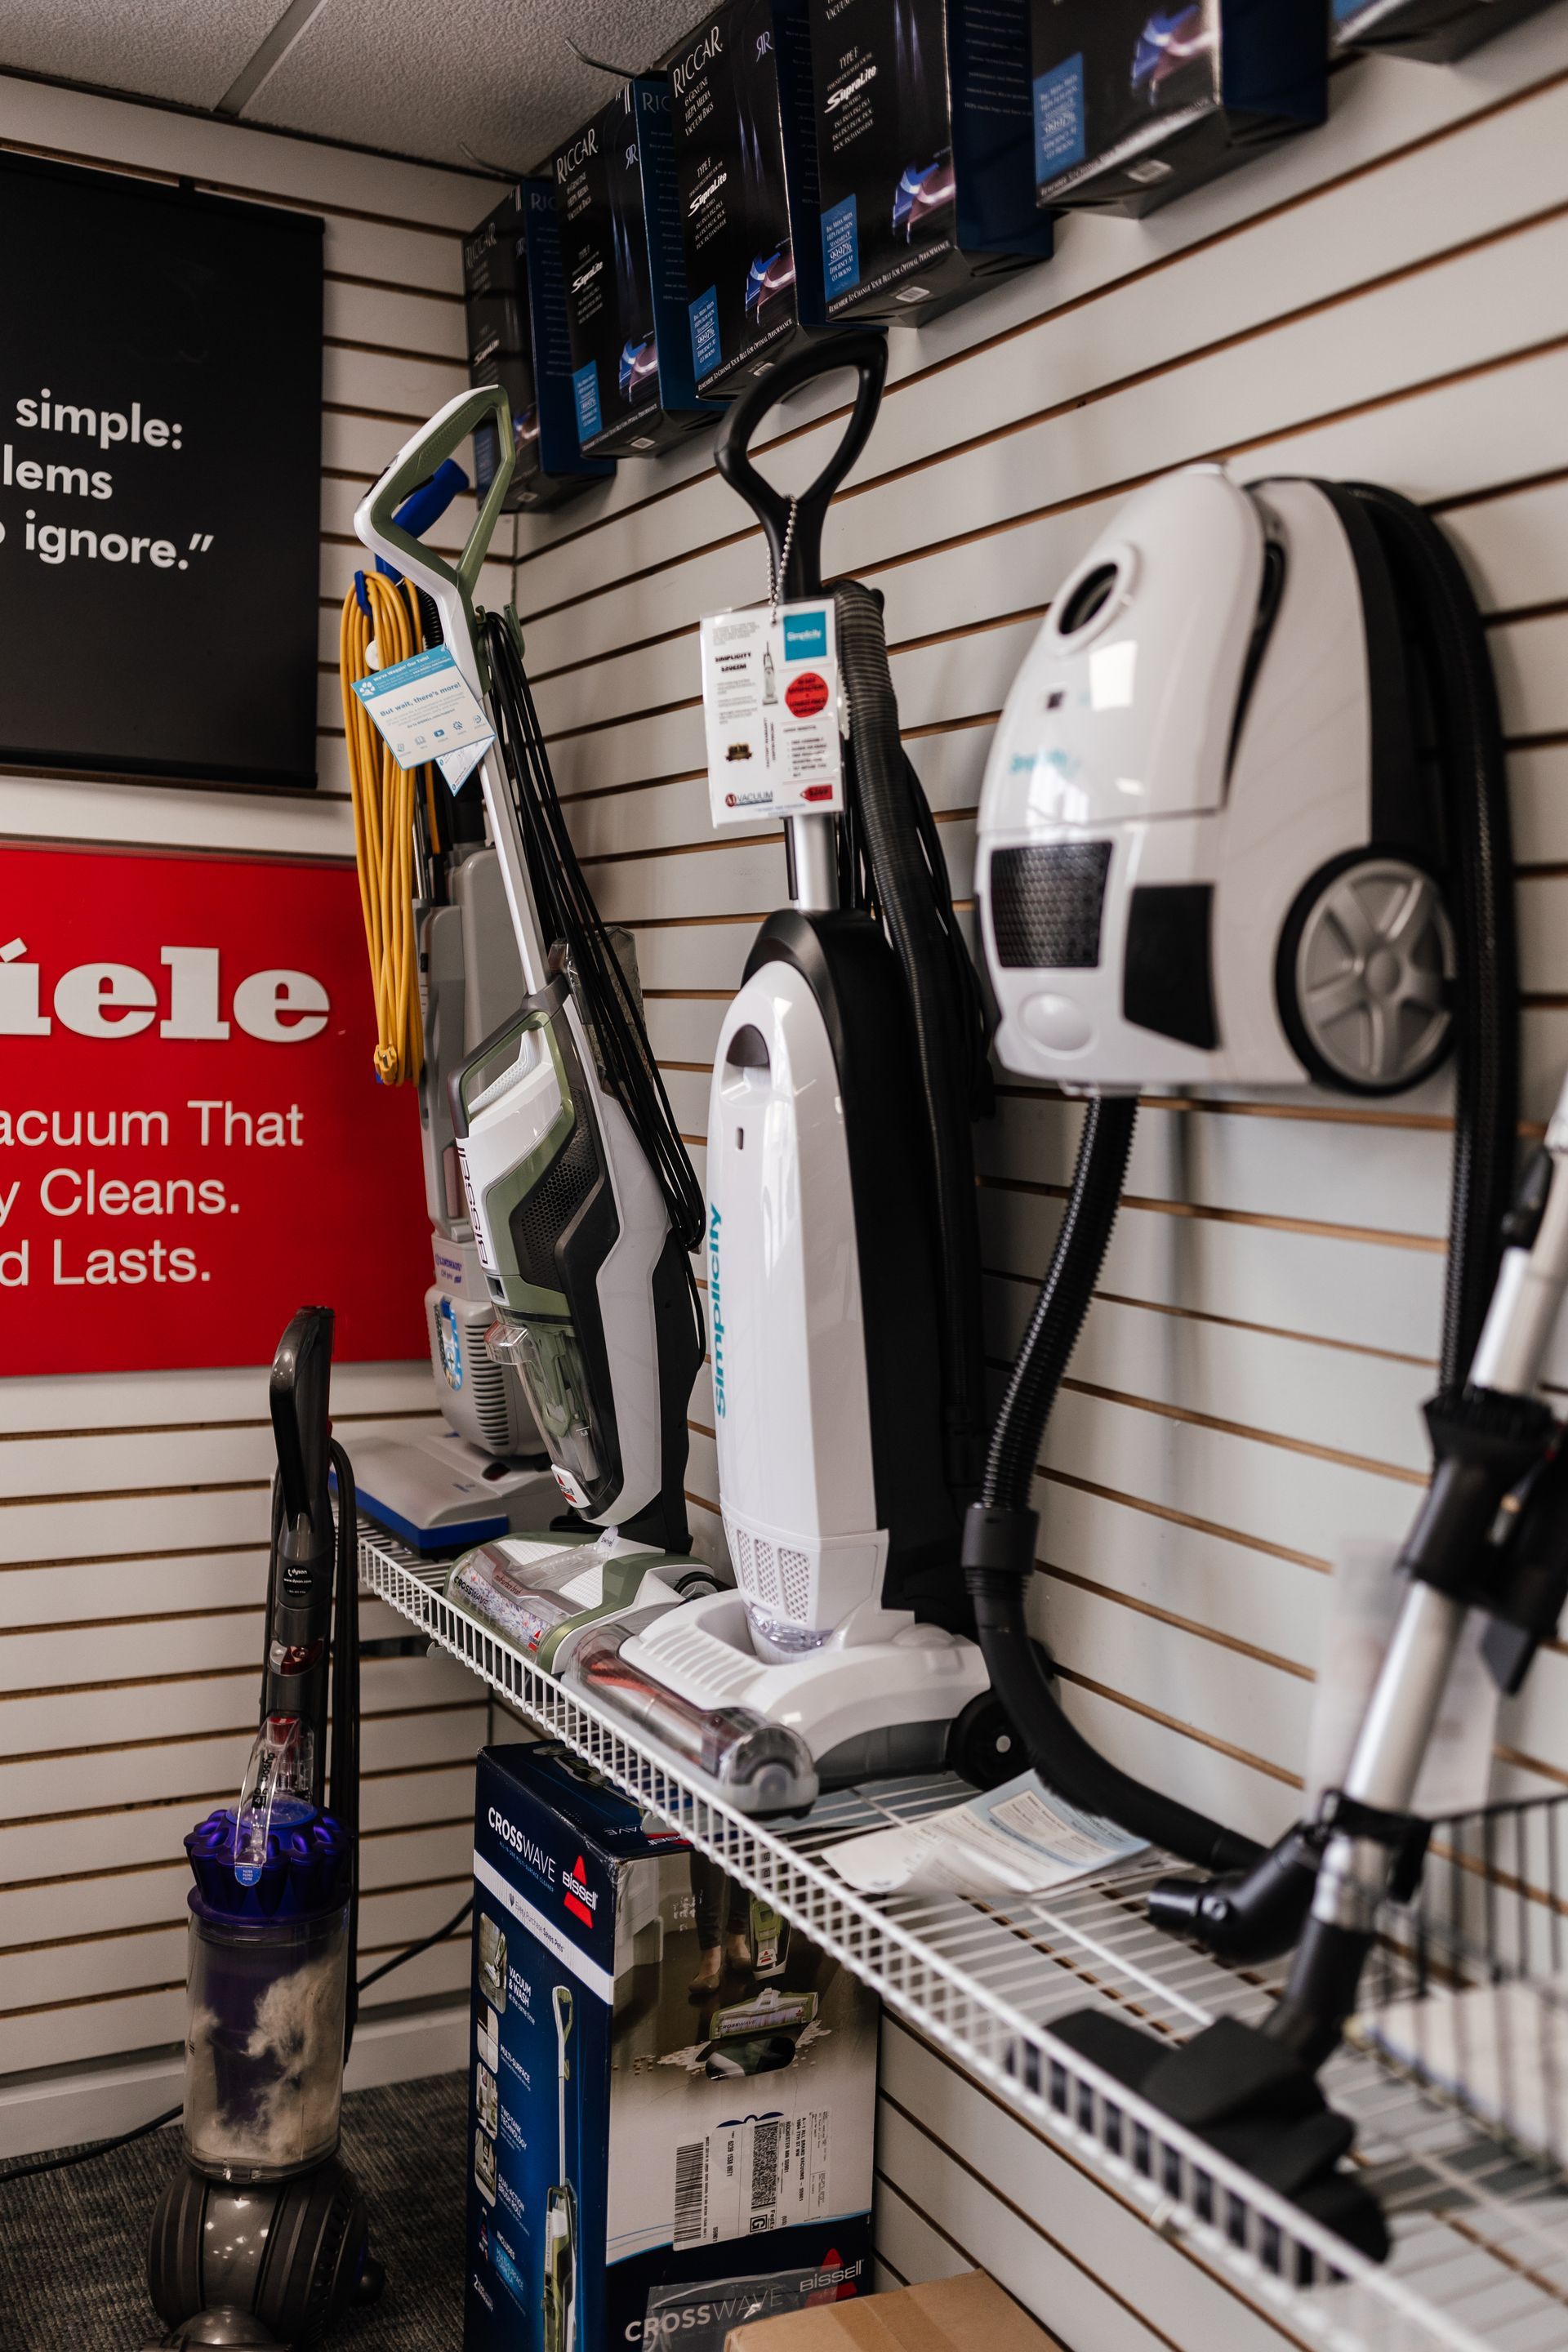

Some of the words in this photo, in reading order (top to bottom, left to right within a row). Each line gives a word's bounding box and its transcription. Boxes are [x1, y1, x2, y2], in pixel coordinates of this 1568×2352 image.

[673, 25, 723, 98] RICCAR
[839, 51, 854, 69] TYPE
[823, 65, 877, 114] SupraLite
[557, 128, 599, 185] RICCAR
[688, 172, 727, 217] SupraLite
[16, 388, 182, 450] simple:
[715, 652, 751, 662] SIMPLICITY
[379, 707, 394, 717] But
[394, 701, 414, 711] wait,
[413, 691, 439, 704] there's
[439, 681, 462, 694] more!
[737, 790, 774, 804] VACUUM
[186, 1100, 305, 1147] That
[39, 1167, 240, 1217] Cleans.
[52, 1238, 212, 1286] Lasts.
[708, 1201, 726, 1419] simplicity
[292, 1568, 308, 1576] dyson
[453, 1575, 489, 1610] CROSSWAVE
[488, 1806, 557, 1883] CROSSWAVE
[539, 1877, 555, 1893] CLEANER
[542, 1927, 555, 1944] Saves
[554, 1938, 564, 1953] Pets
[508, 1978, 513, 1990] &
[513, 1982, 529, 2008] WASH
[509, 1965, 532, 1997] VACUUM
[500, 2043, 530, 2083] MULTI-SURFACE
[501, 2104, 522, 2135] TWO-TANK
[501, 2114, 527, 2149] TECHNOLOGY
[785, 2151, 790, 2159] MN
[498, 2173, 524, 2212] DUAL-ACTION
[498, 2181, 511, 2205] BRUSH
[511, 2198, 523, 2219] ROLL
[752, 2217, 765, 2230] G
[497, 2230, 515, 2260] INCLUDES
[625, 2287, 783, 2343] CROSSWAVE
